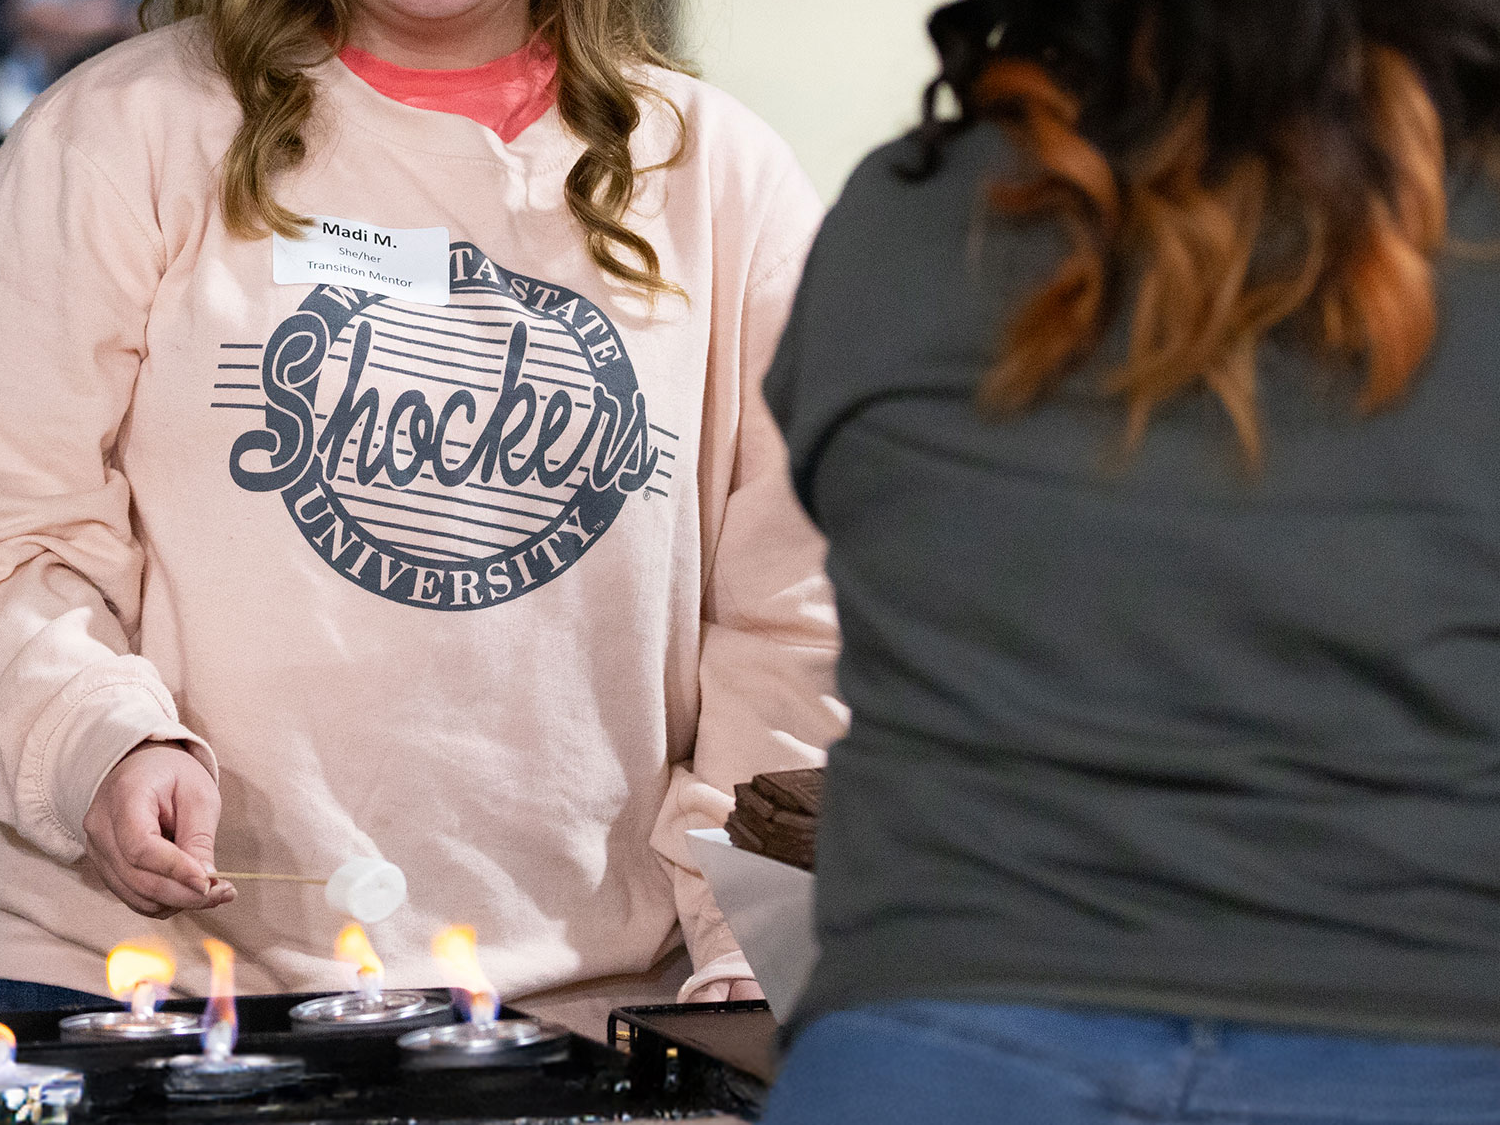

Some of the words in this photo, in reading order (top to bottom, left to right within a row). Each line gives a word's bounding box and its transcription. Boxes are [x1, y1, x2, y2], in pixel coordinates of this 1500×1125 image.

[322, 221, 368, 242] Madi
[374, 233, 398, 248] M.
[338, 247, 382, 263] She/her
[307, 261, 366, 277] Transition
[368, 270, 413, 288] Mentor
[509, 277, 622, 369] STATE
[228, 309, 660, 493] Shockers
[294, 482, 596, 606] UNIVERSITY
